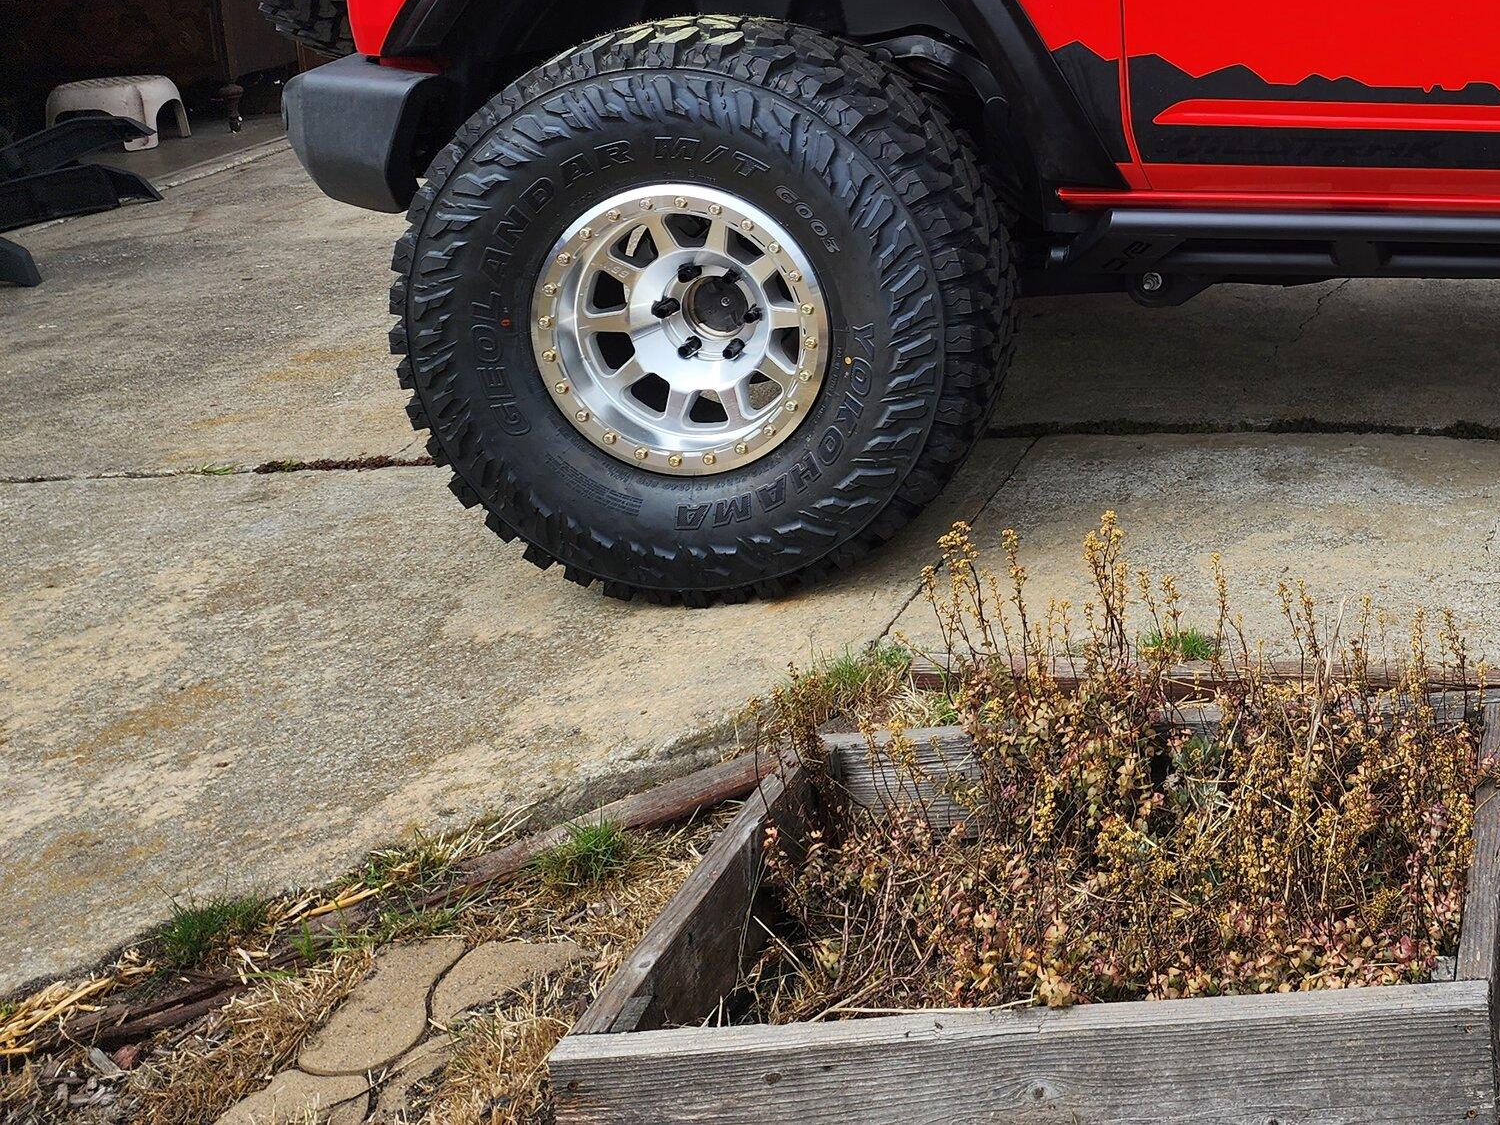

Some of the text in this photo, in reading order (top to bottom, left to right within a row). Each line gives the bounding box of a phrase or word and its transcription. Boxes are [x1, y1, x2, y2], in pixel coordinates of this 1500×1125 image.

[468, 134, 841, 439] GEOLANDAR M/T G003
[672, 321, 877, 531] YOKOHAMA
